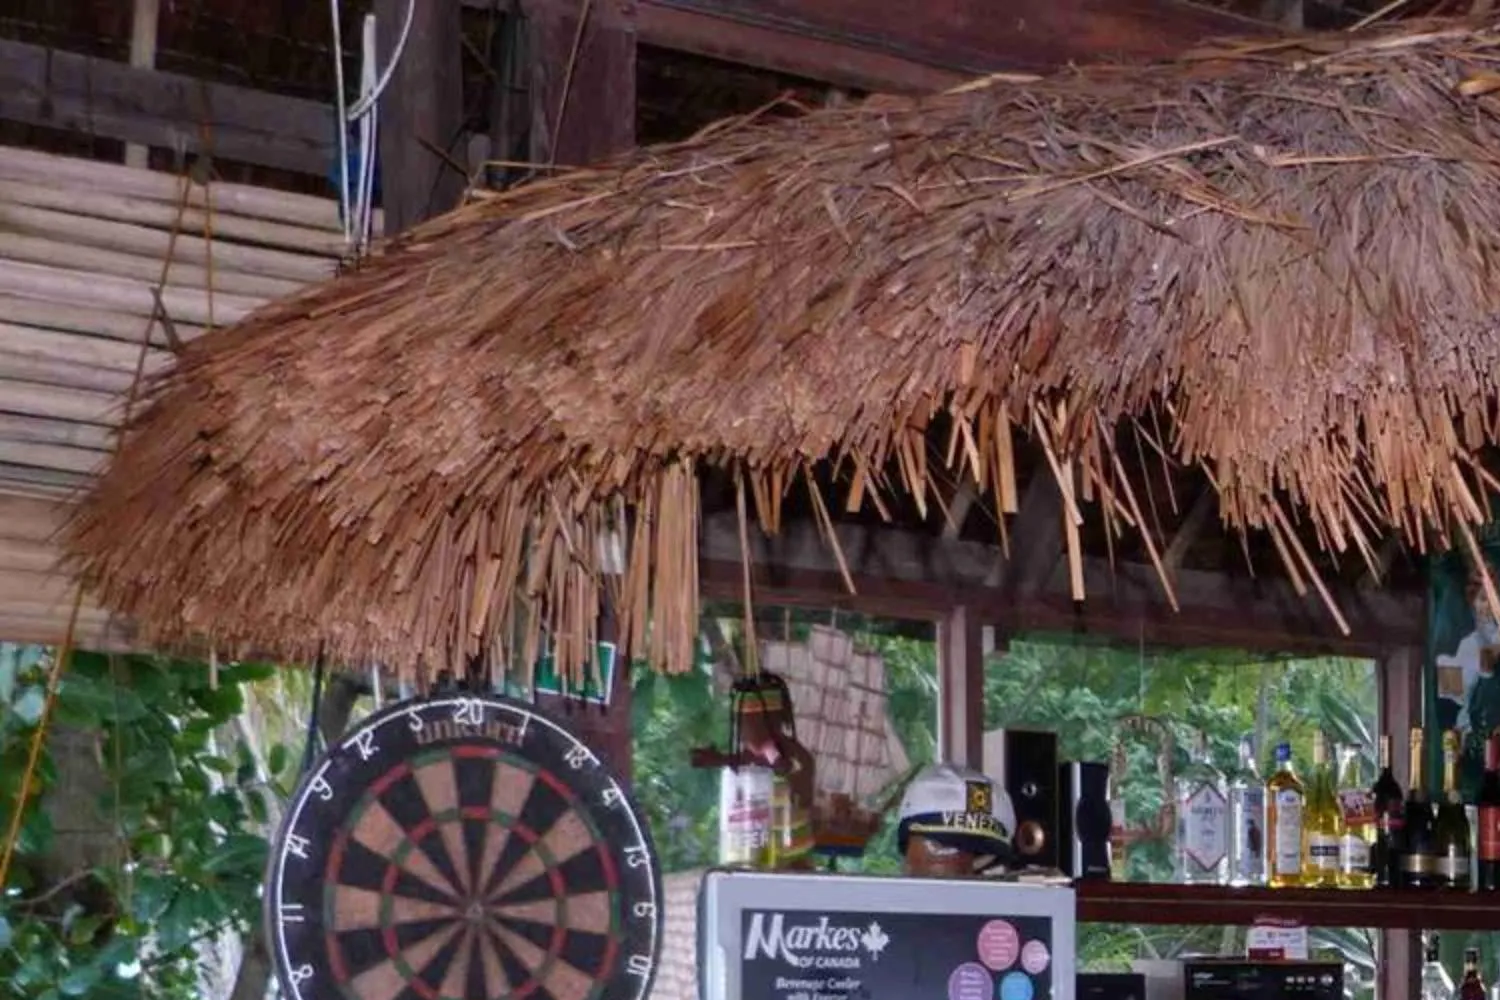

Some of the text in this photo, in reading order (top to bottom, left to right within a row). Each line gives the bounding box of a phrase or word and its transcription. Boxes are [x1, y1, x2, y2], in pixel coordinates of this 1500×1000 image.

[453, 697, 483, 726] 20
[353, 728, 381, 761] 12
[564, 745, 589, 770] 18
[311, 774, 334, 800] 9
[286, 833, 311, 860] 14
[624, 845, 650, 868] 13
[279, 904, 305, 922] 11
[633, 901, 656, 918] 6
[744, 912, 861, 968] Markes
[289, 963, 314, 985] 8
[626, 954, 651, 977] 10
[799, 955, 861, 969] OF CANADA
